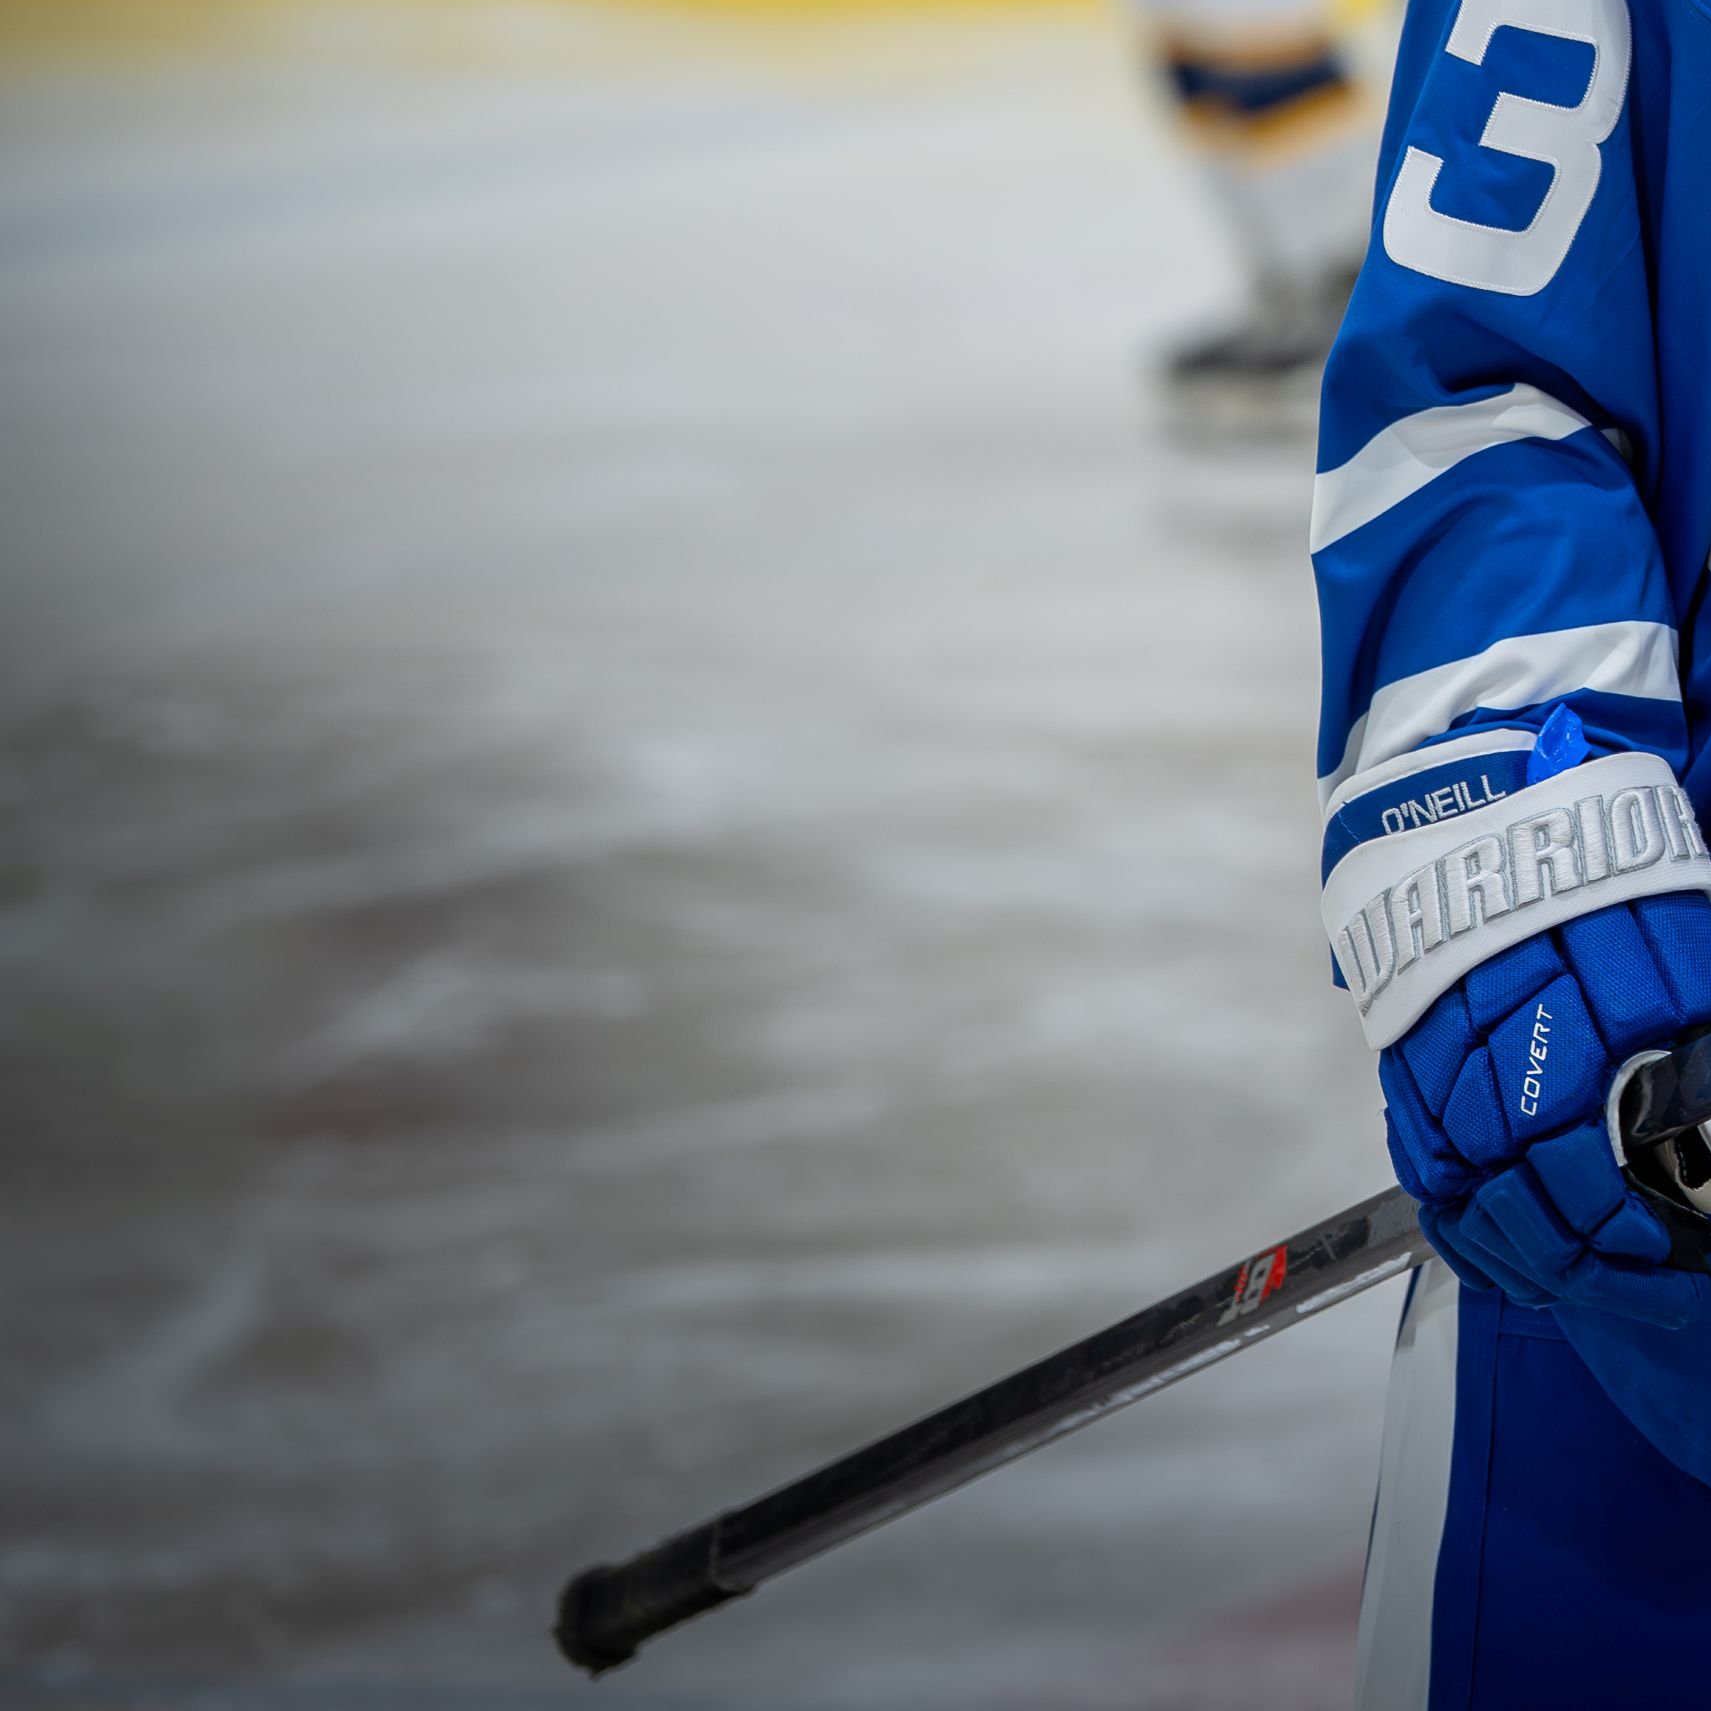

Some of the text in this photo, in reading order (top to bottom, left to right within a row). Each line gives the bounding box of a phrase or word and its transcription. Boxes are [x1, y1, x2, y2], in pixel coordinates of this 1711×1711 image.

[1381, 774, 1507, 836] O'NEILL
[1338, 784, 1711, 1017] WARRIOR
[1520, 1003, 1553, 1117] COVERT
